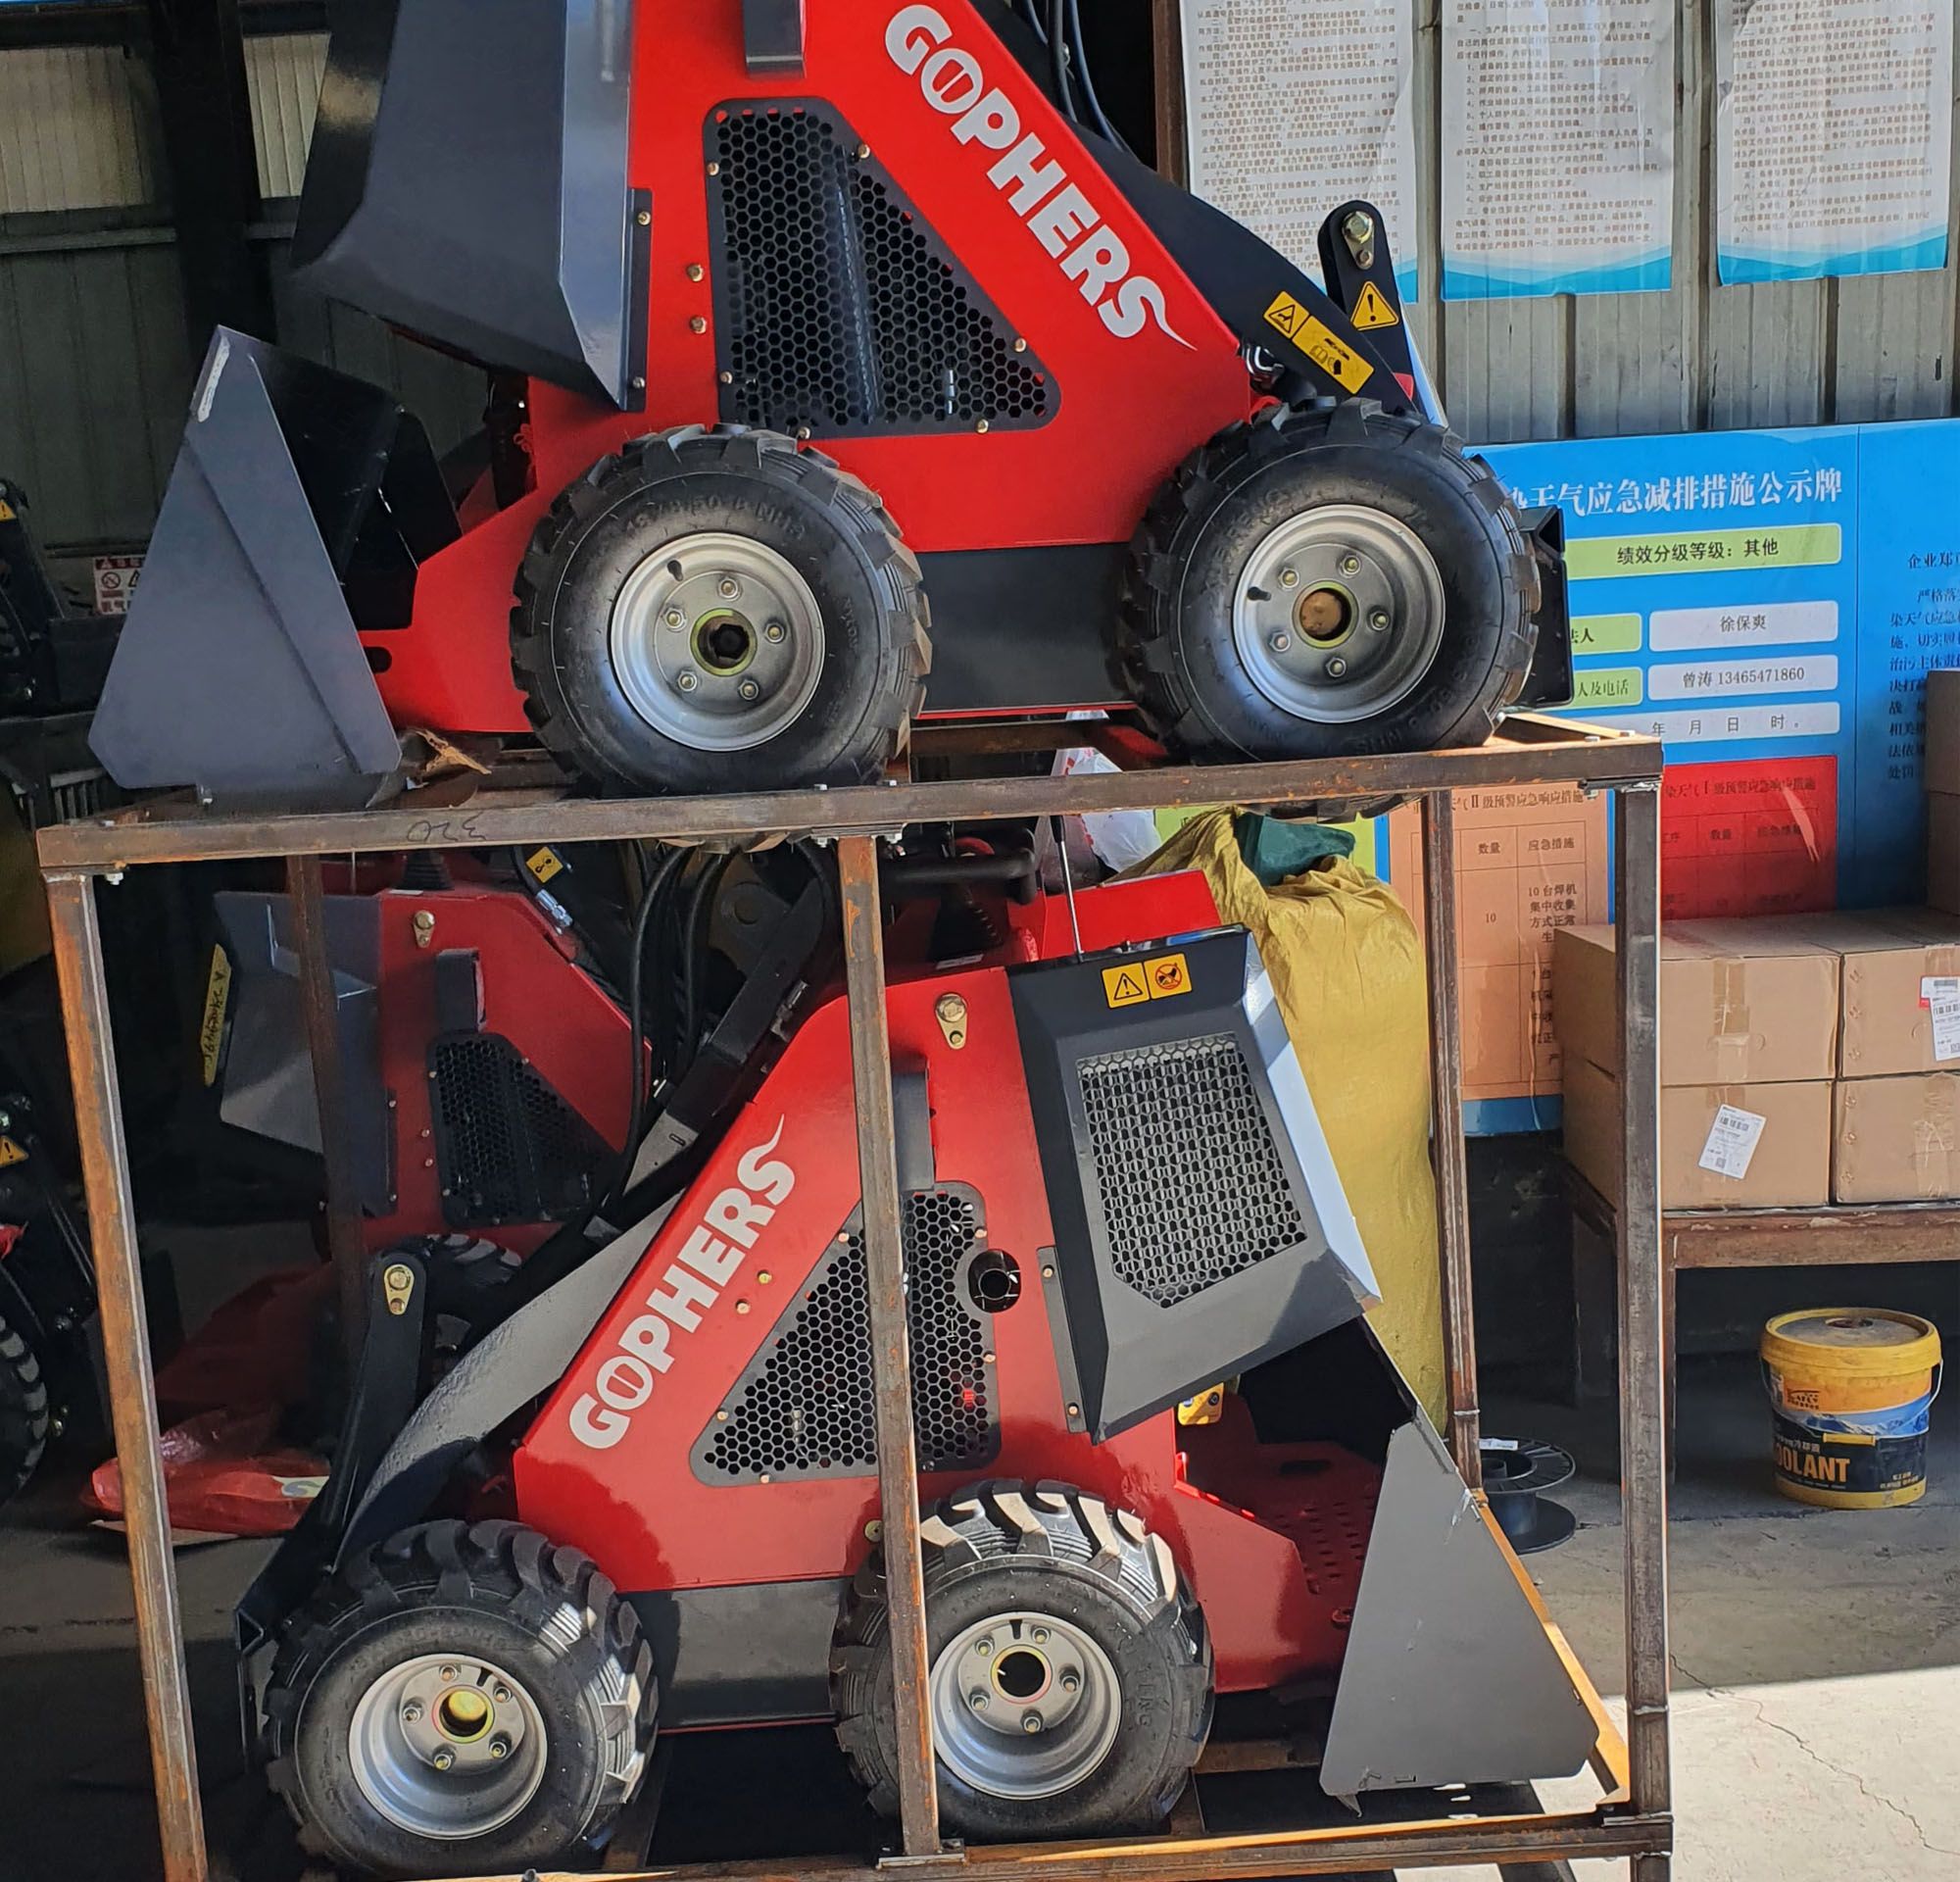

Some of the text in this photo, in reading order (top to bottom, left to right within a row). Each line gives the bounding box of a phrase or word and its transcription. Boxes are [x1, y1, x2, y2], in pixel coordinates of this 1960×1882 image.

[885, 4, 1198, 351] GOPHERS
[1617, 538, 1780, 565] 绩效分级等级：其他
[1720, 615, 1767, 632] 徐保爽
[1683, 667, 1805, 688] 曾涛 13465471860
[1652, 721, 1665, 735] 年
[1690, 720, 1702, 734] 月
[1728, 718, 1740, 732] 日
[1478, 842, 1500, 856] 数量
[1528, 836, 1575, 852] 应急措施
[1528, 886, 1540, 897] 10
[1486, 912, 1496, 923] 10
[569, 1113, 796, 1450] GOPHERS
